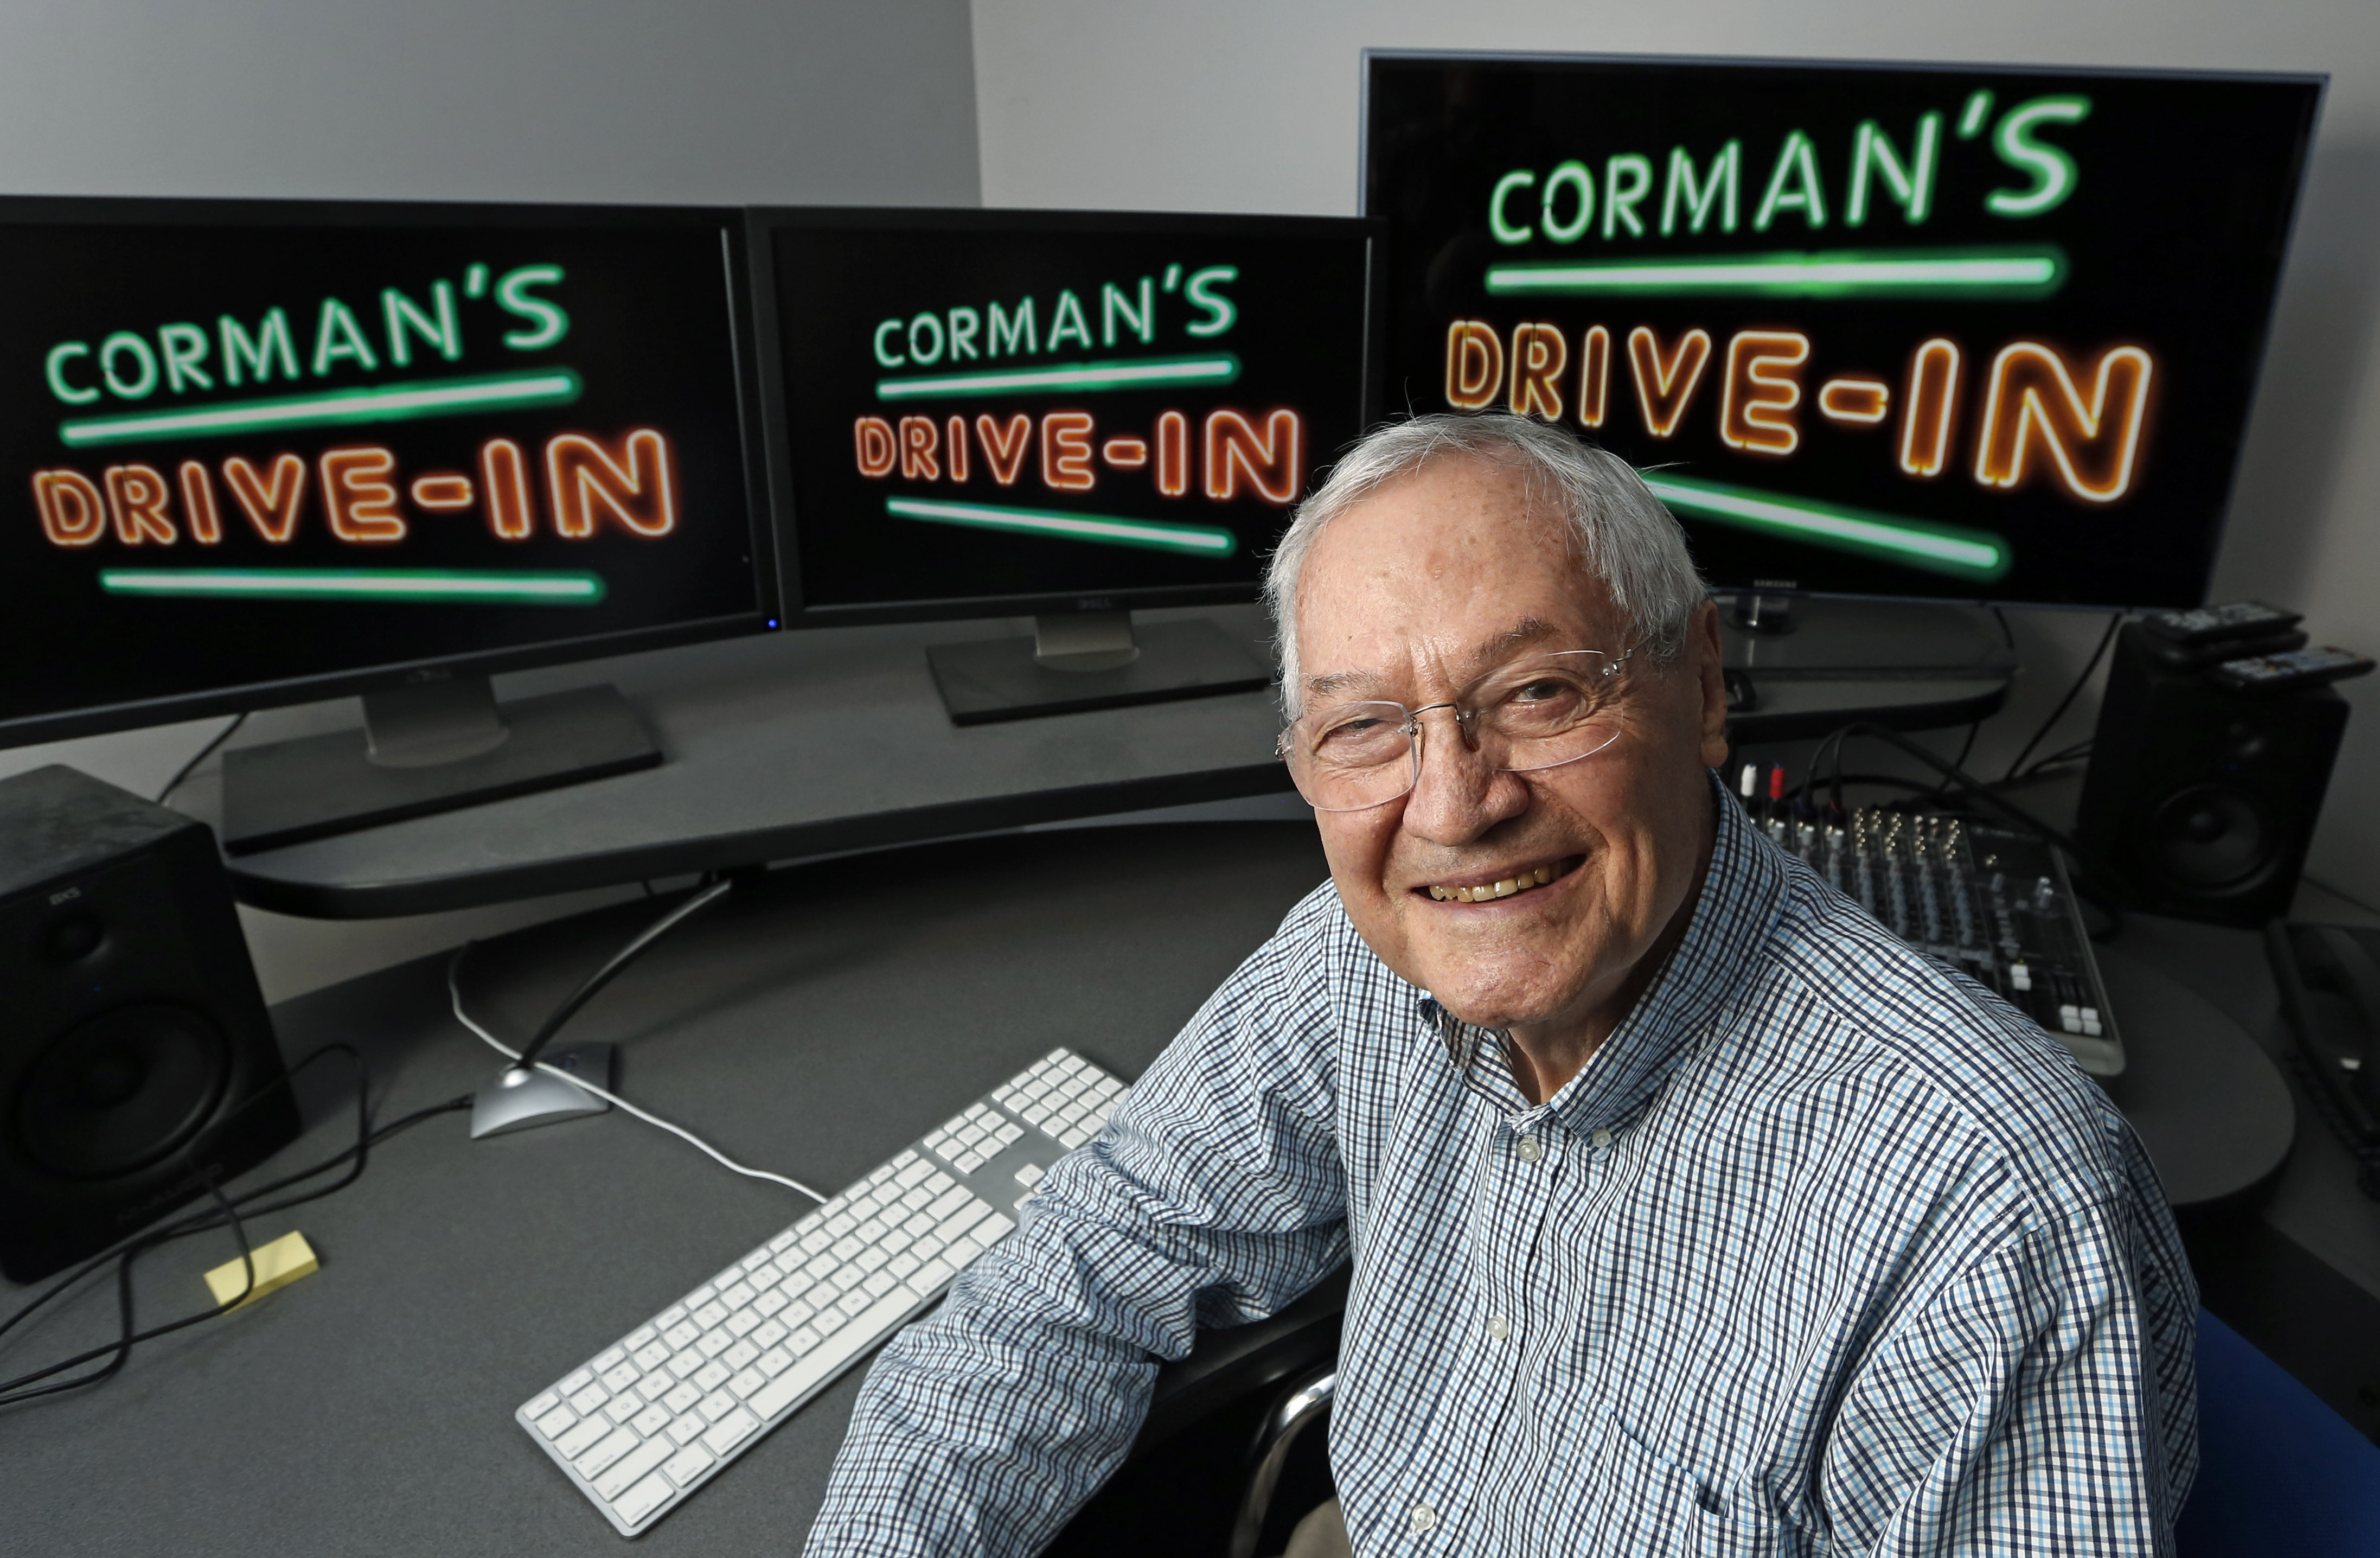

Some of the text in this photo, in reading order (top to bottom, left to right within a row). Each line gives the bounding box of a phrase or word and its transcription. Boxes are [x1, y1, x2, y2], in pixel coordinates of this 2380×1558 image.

[1489, 91, 2089, 244] CORMAN'S
[46, 263, 568, 404] CORMAN'S
[874, 264, 1237, 368] CORMAN'S
[854, 408, 1301, 503] DRIVE-IN
[1445, 320, 2153, 502] DRIVE-IN
[31, 427, 677, 547] DRIVE-IN
